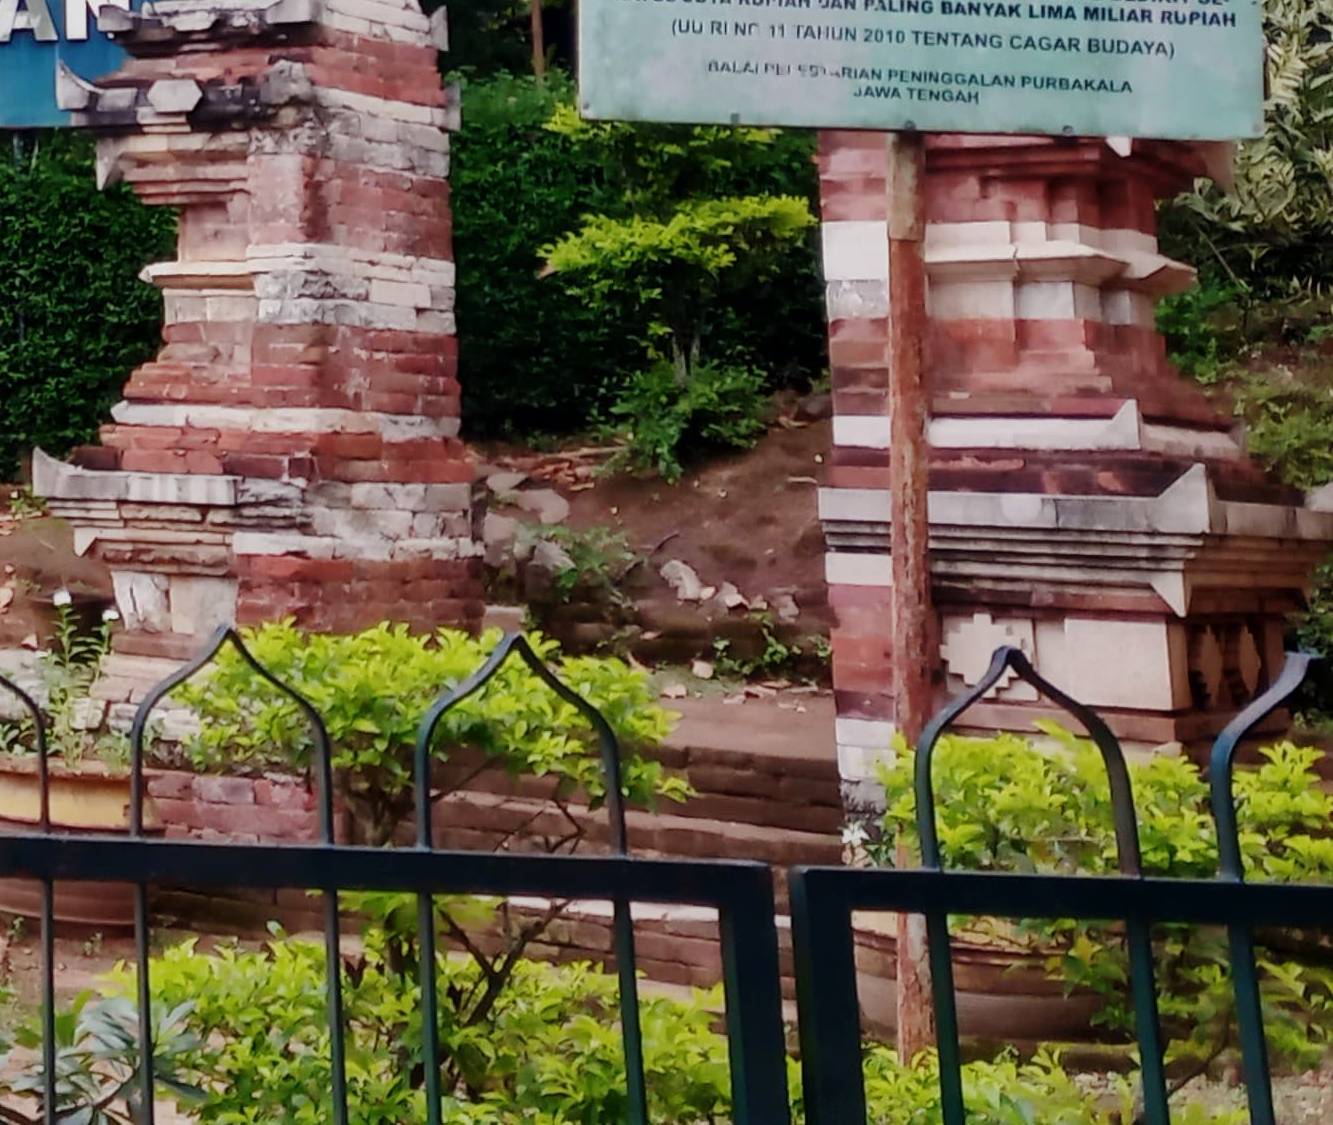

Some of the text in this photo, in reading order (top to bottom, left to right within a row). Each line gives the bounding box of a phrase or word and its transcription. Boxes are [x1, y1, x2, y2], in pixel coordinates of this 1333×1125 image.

[940, 0, 1022, 19] BANYAK
[1028, 4, 1077, 20] LIMA
[1083, 6, 1153, 23] MILIAR
[1160, 10, 1237, 27] RUPIAH
[671, 18, 703, 35] (UU
[710, 20, 728, 36] RI
[795, 24, 857, 42] TAHUN
[863, 28, 906, 45] 2010
[911, 30, 1003, 49] TENTANG
[1009, 34, 1081, 52] CAGAR
[1087, 37, 1175, 59] BUDAYA)
[888, 68, 1016, 88] PENINGGALAN
[1021, 75, 1134, 93] PURBAKALA
[853, 85, 980, 105] JAWA TENGAH
